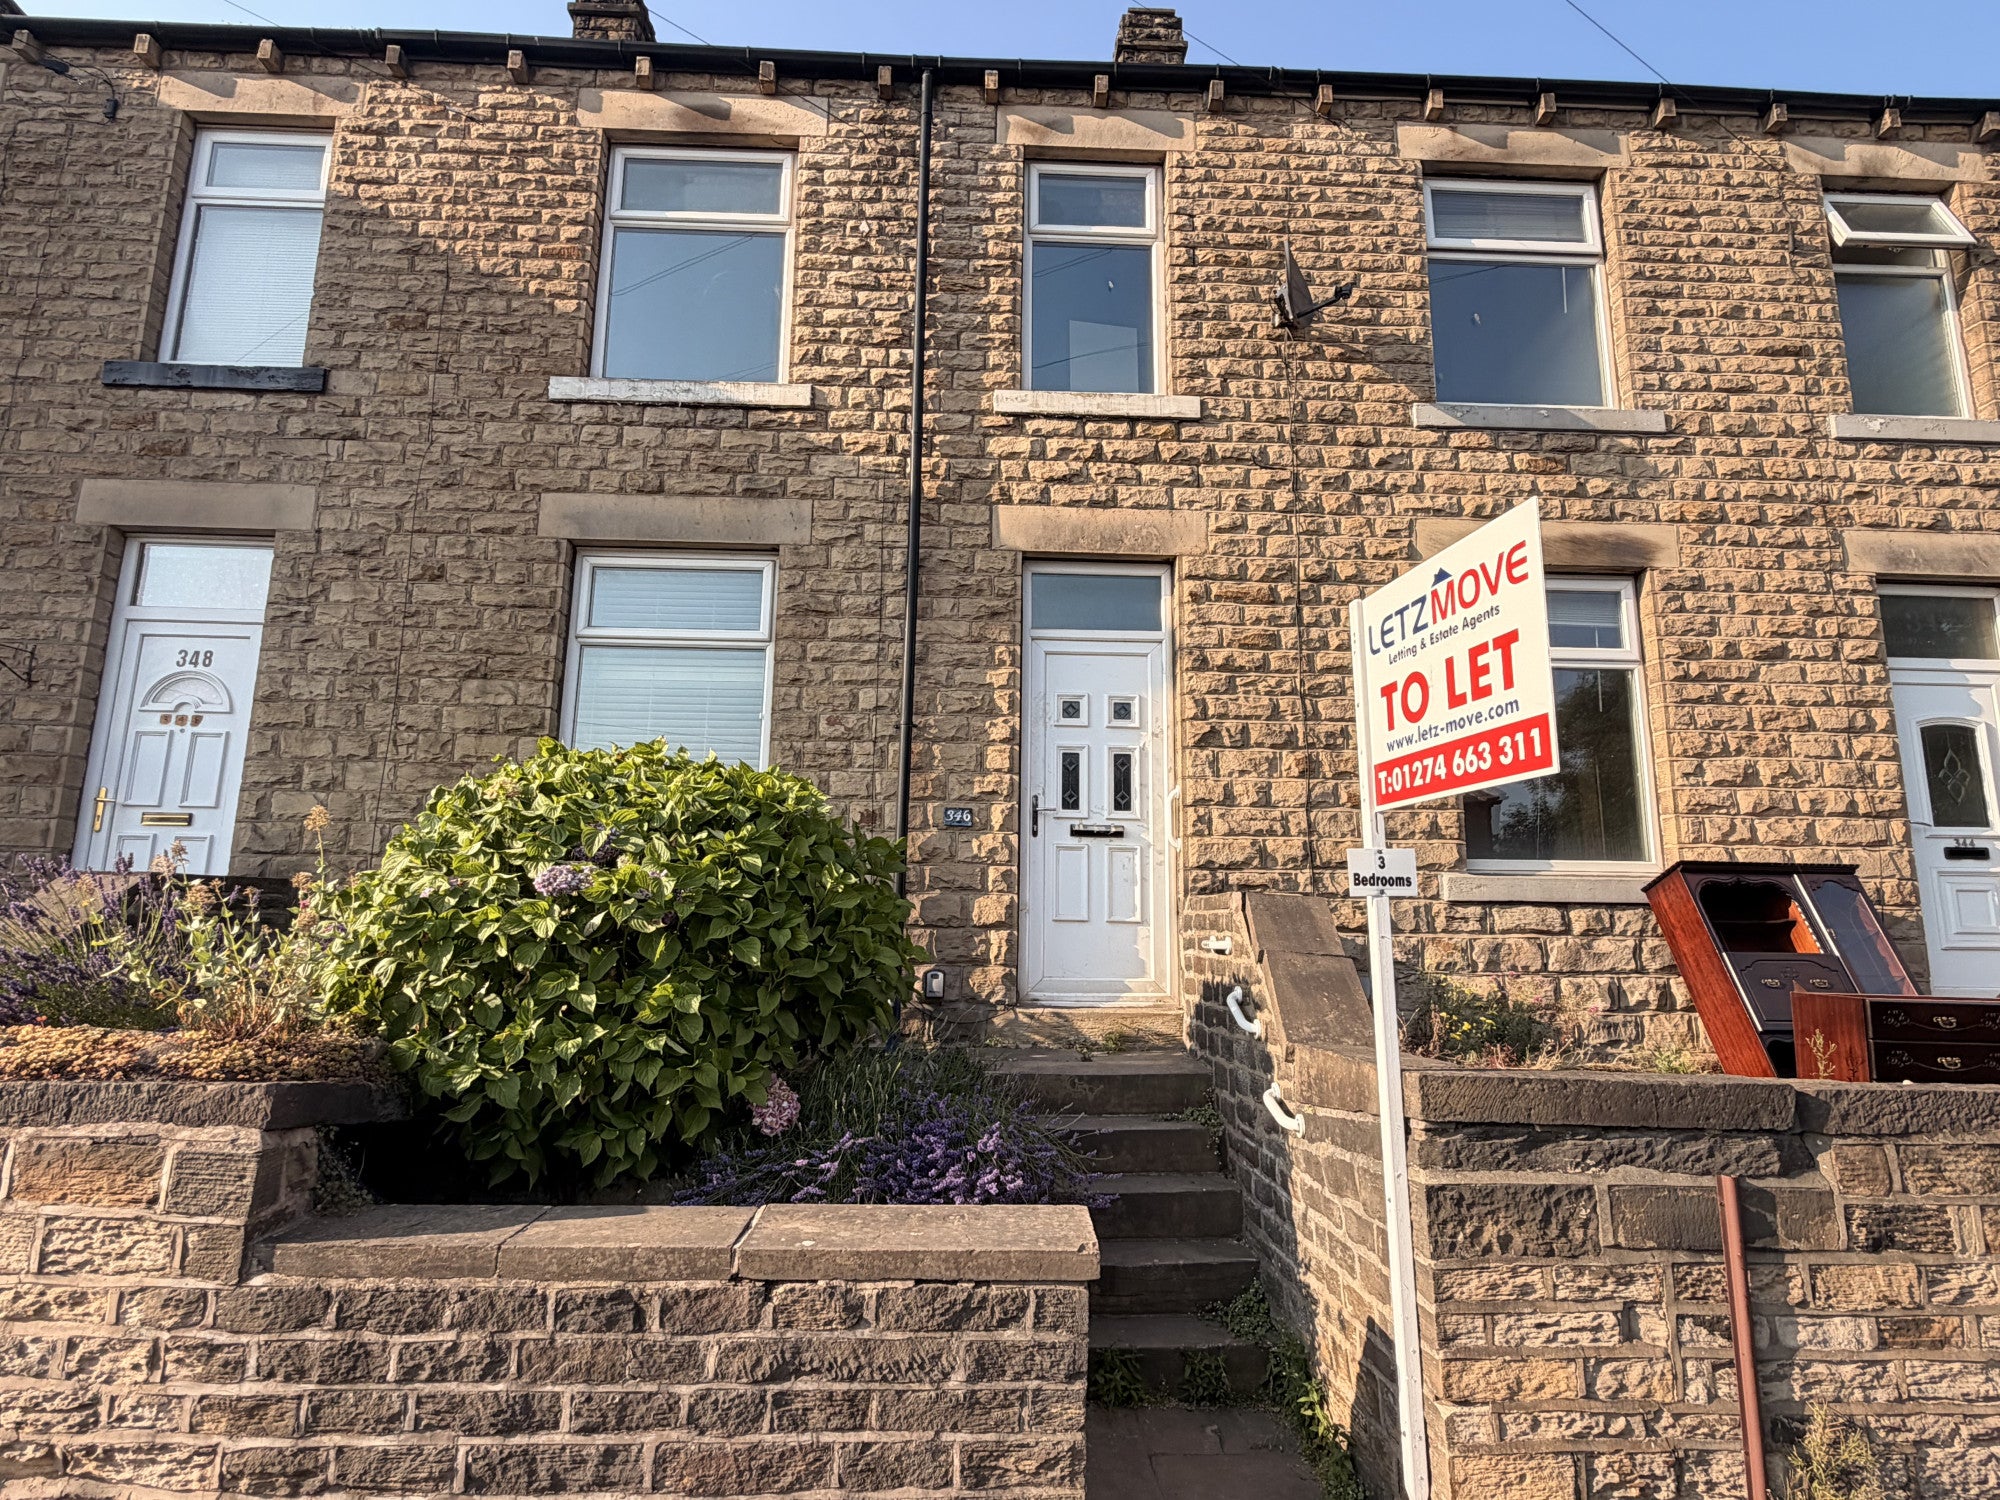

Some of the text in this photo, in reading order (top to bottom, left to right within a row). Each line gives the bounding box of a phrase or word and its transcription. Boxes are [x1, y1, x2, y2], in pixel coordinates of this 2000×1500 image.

[1368, 539, 1529, 656] LETZMOVE
[176, 649, 214, 668] 348
[1388, 605, 1500, 665] Letting & Estate Agents
[1380, 628, 1520, 732] TO LET
[1386, 698, 1520, 753] www.letz-move.com
[1378, 727, 1542, 795] T:01274 663 311
[945, 809, 971, 822] 346
[1353, 872, 1412, 887] Bedrooms
[1378, 855, 1386, 869] 3
